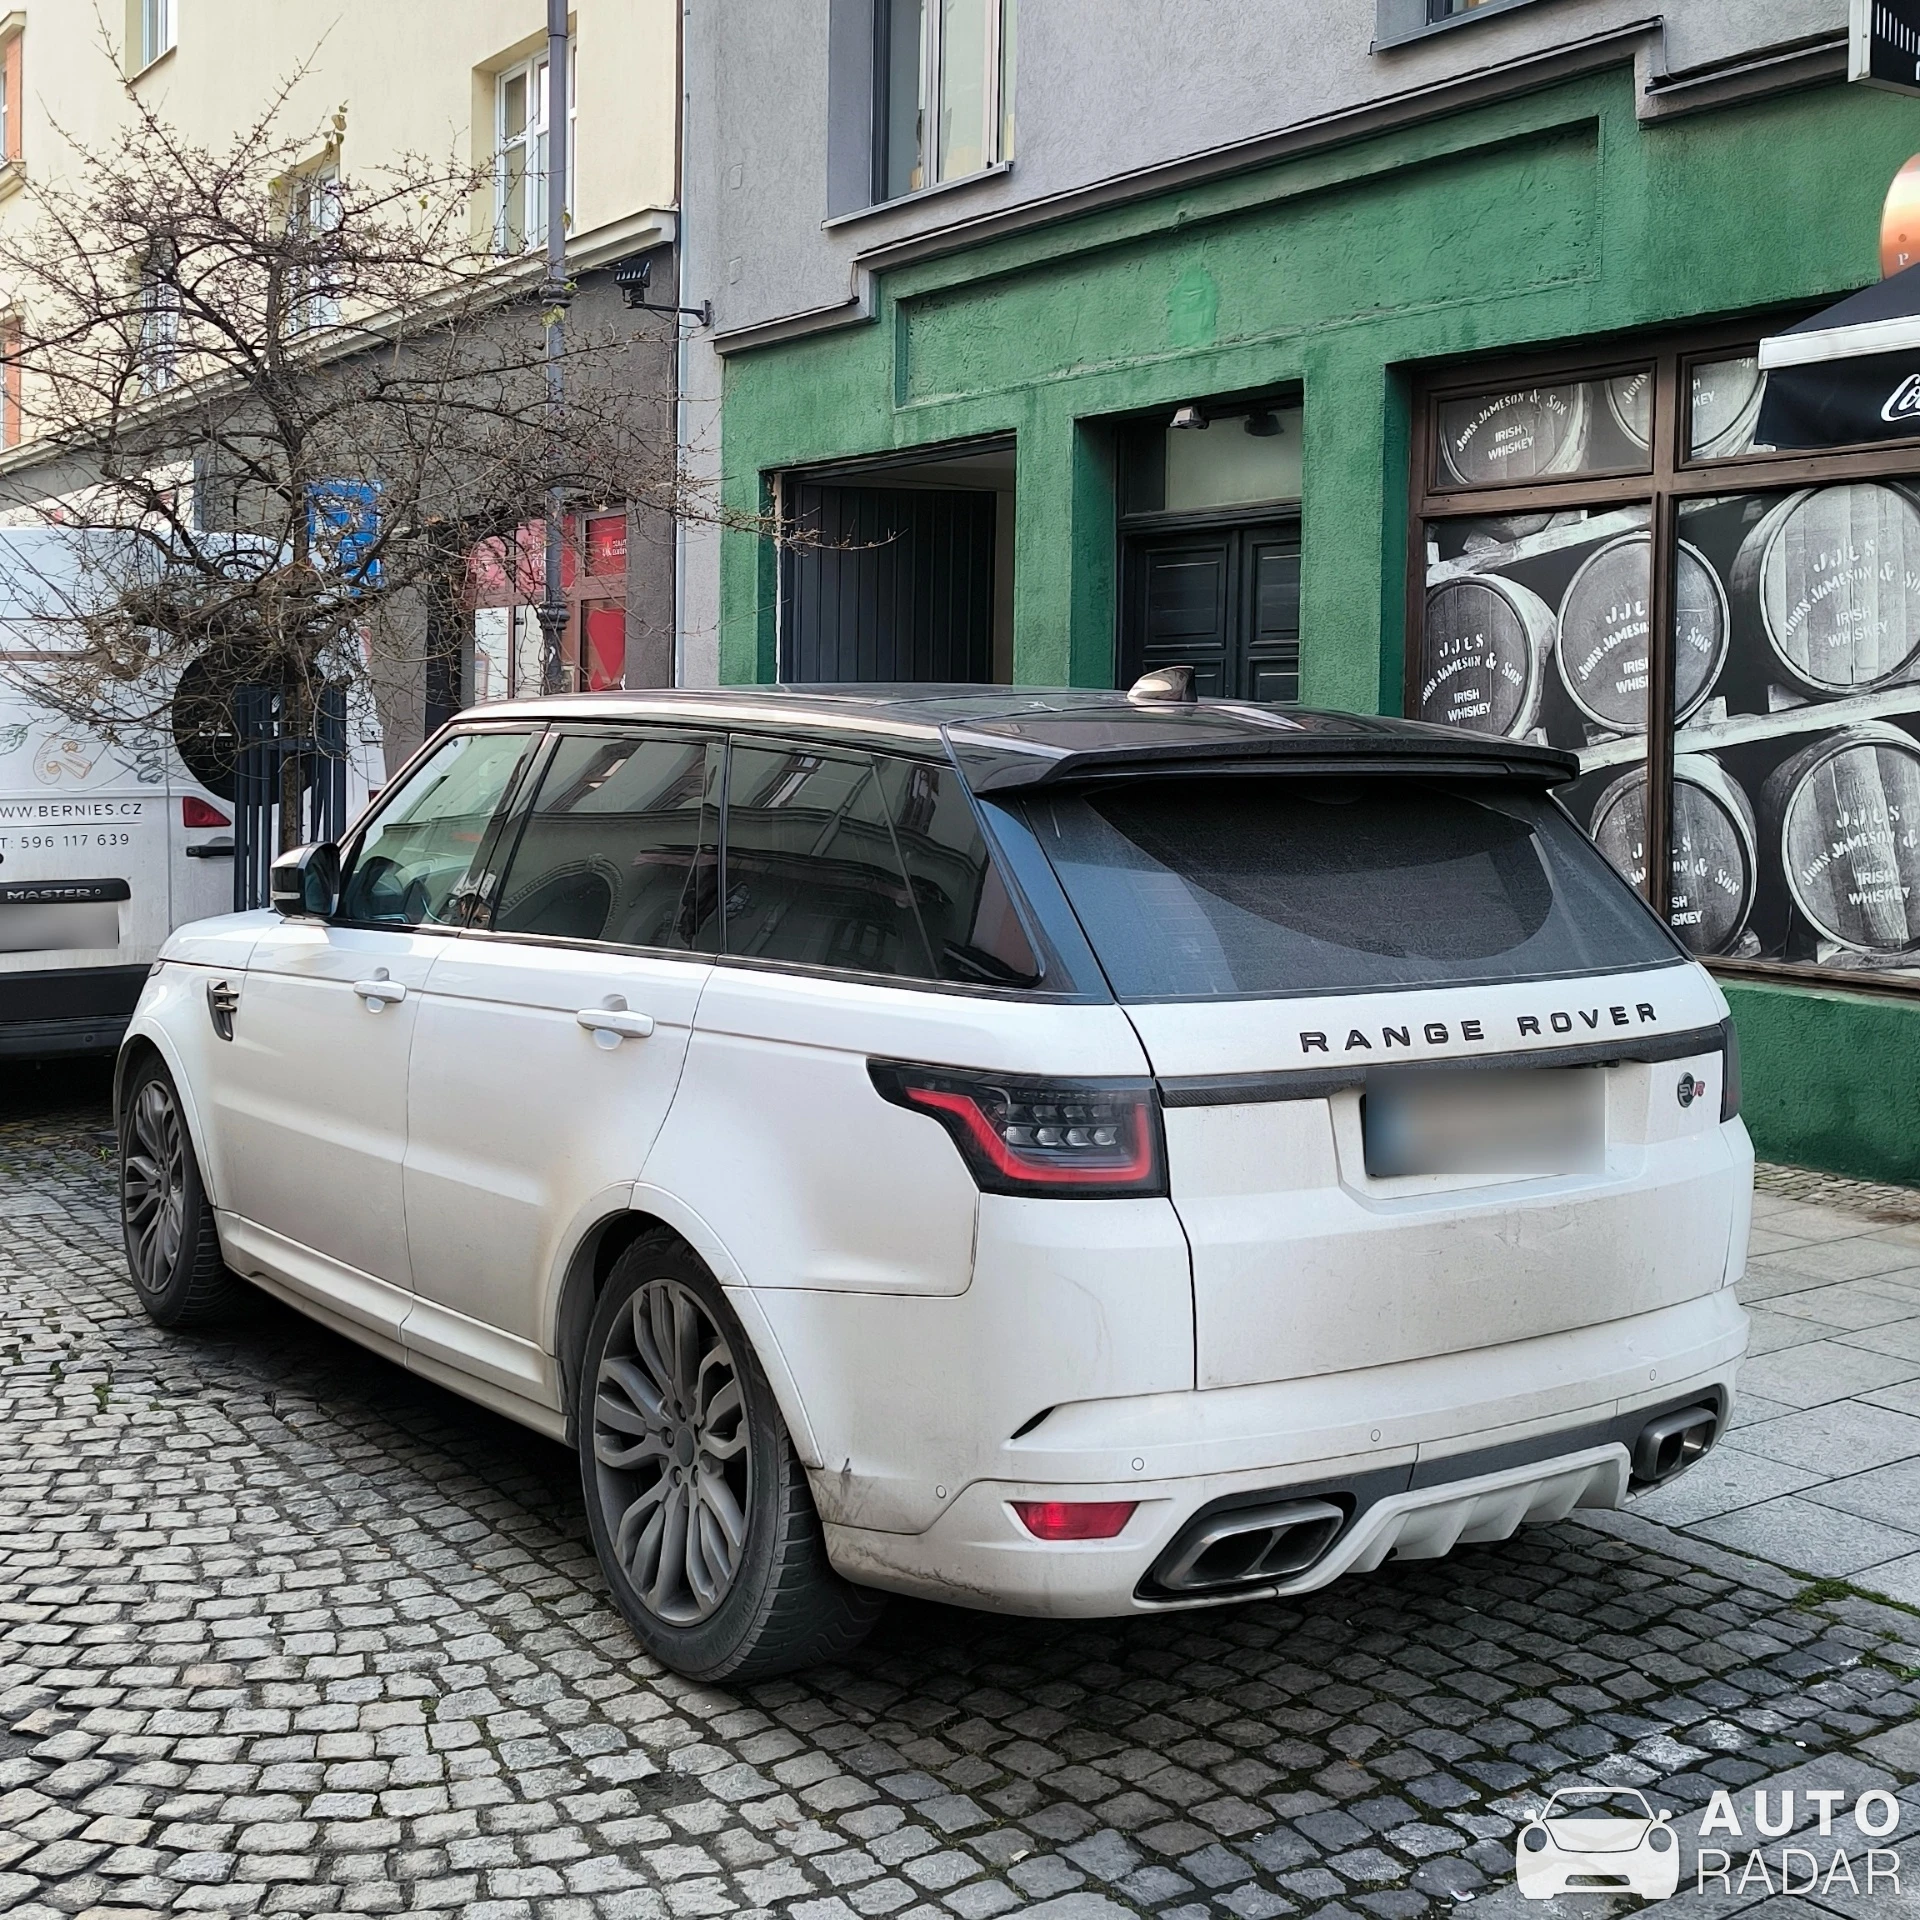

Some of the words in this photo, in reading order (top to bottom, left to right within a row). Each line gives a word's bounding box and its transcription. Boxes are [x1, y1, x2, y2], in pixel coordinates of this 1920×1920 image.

[1456, 421, 1478, 452] JOHN
[1478, 393, 1524, 424] JAMESON
[1546, 394, 1567, 416] SON
[1495, 424, 1522, 442] IRISH
[1488, 436, 1534, 461] WHISKEY
[1783, 598, 1812, 636] JOHN
[1810, 566, 1873, 603] JAMESON
[1906, 570, 1920, 595] SO
[1836, 606, 1871, 627] IRISH
[1578, 646, 1604, 681] JOHN
[1687, 626, 1712, 654] SON
[1437, 655, 1481, 683] JAMESON
[1502, 661, 1523, 686] SON
[1615, 675, 1648, 694] WHIS
[1453, 688, 1480, 704] IRISH
[1447, 702, 1491, 722] WHISKEY
[21, 836, 54, 849] 596
[64, 834, 88, 847] 117
[97, 833, 129, 846] 639
[1802, 851, 1831, 886] JOHN
[1857, 869, 1895, 886] IRISH
[1715, 868, 1739, 896] SON
[7, 888, 91, 900] MASTER
[1848, 886, 1911, 905] WHISKEY
[1300, 1019, 1485, 1053] RANGE
[1517, 1003, 1657, 1037] ROVER
[1678, 1079, 1706, 1098] SVR
